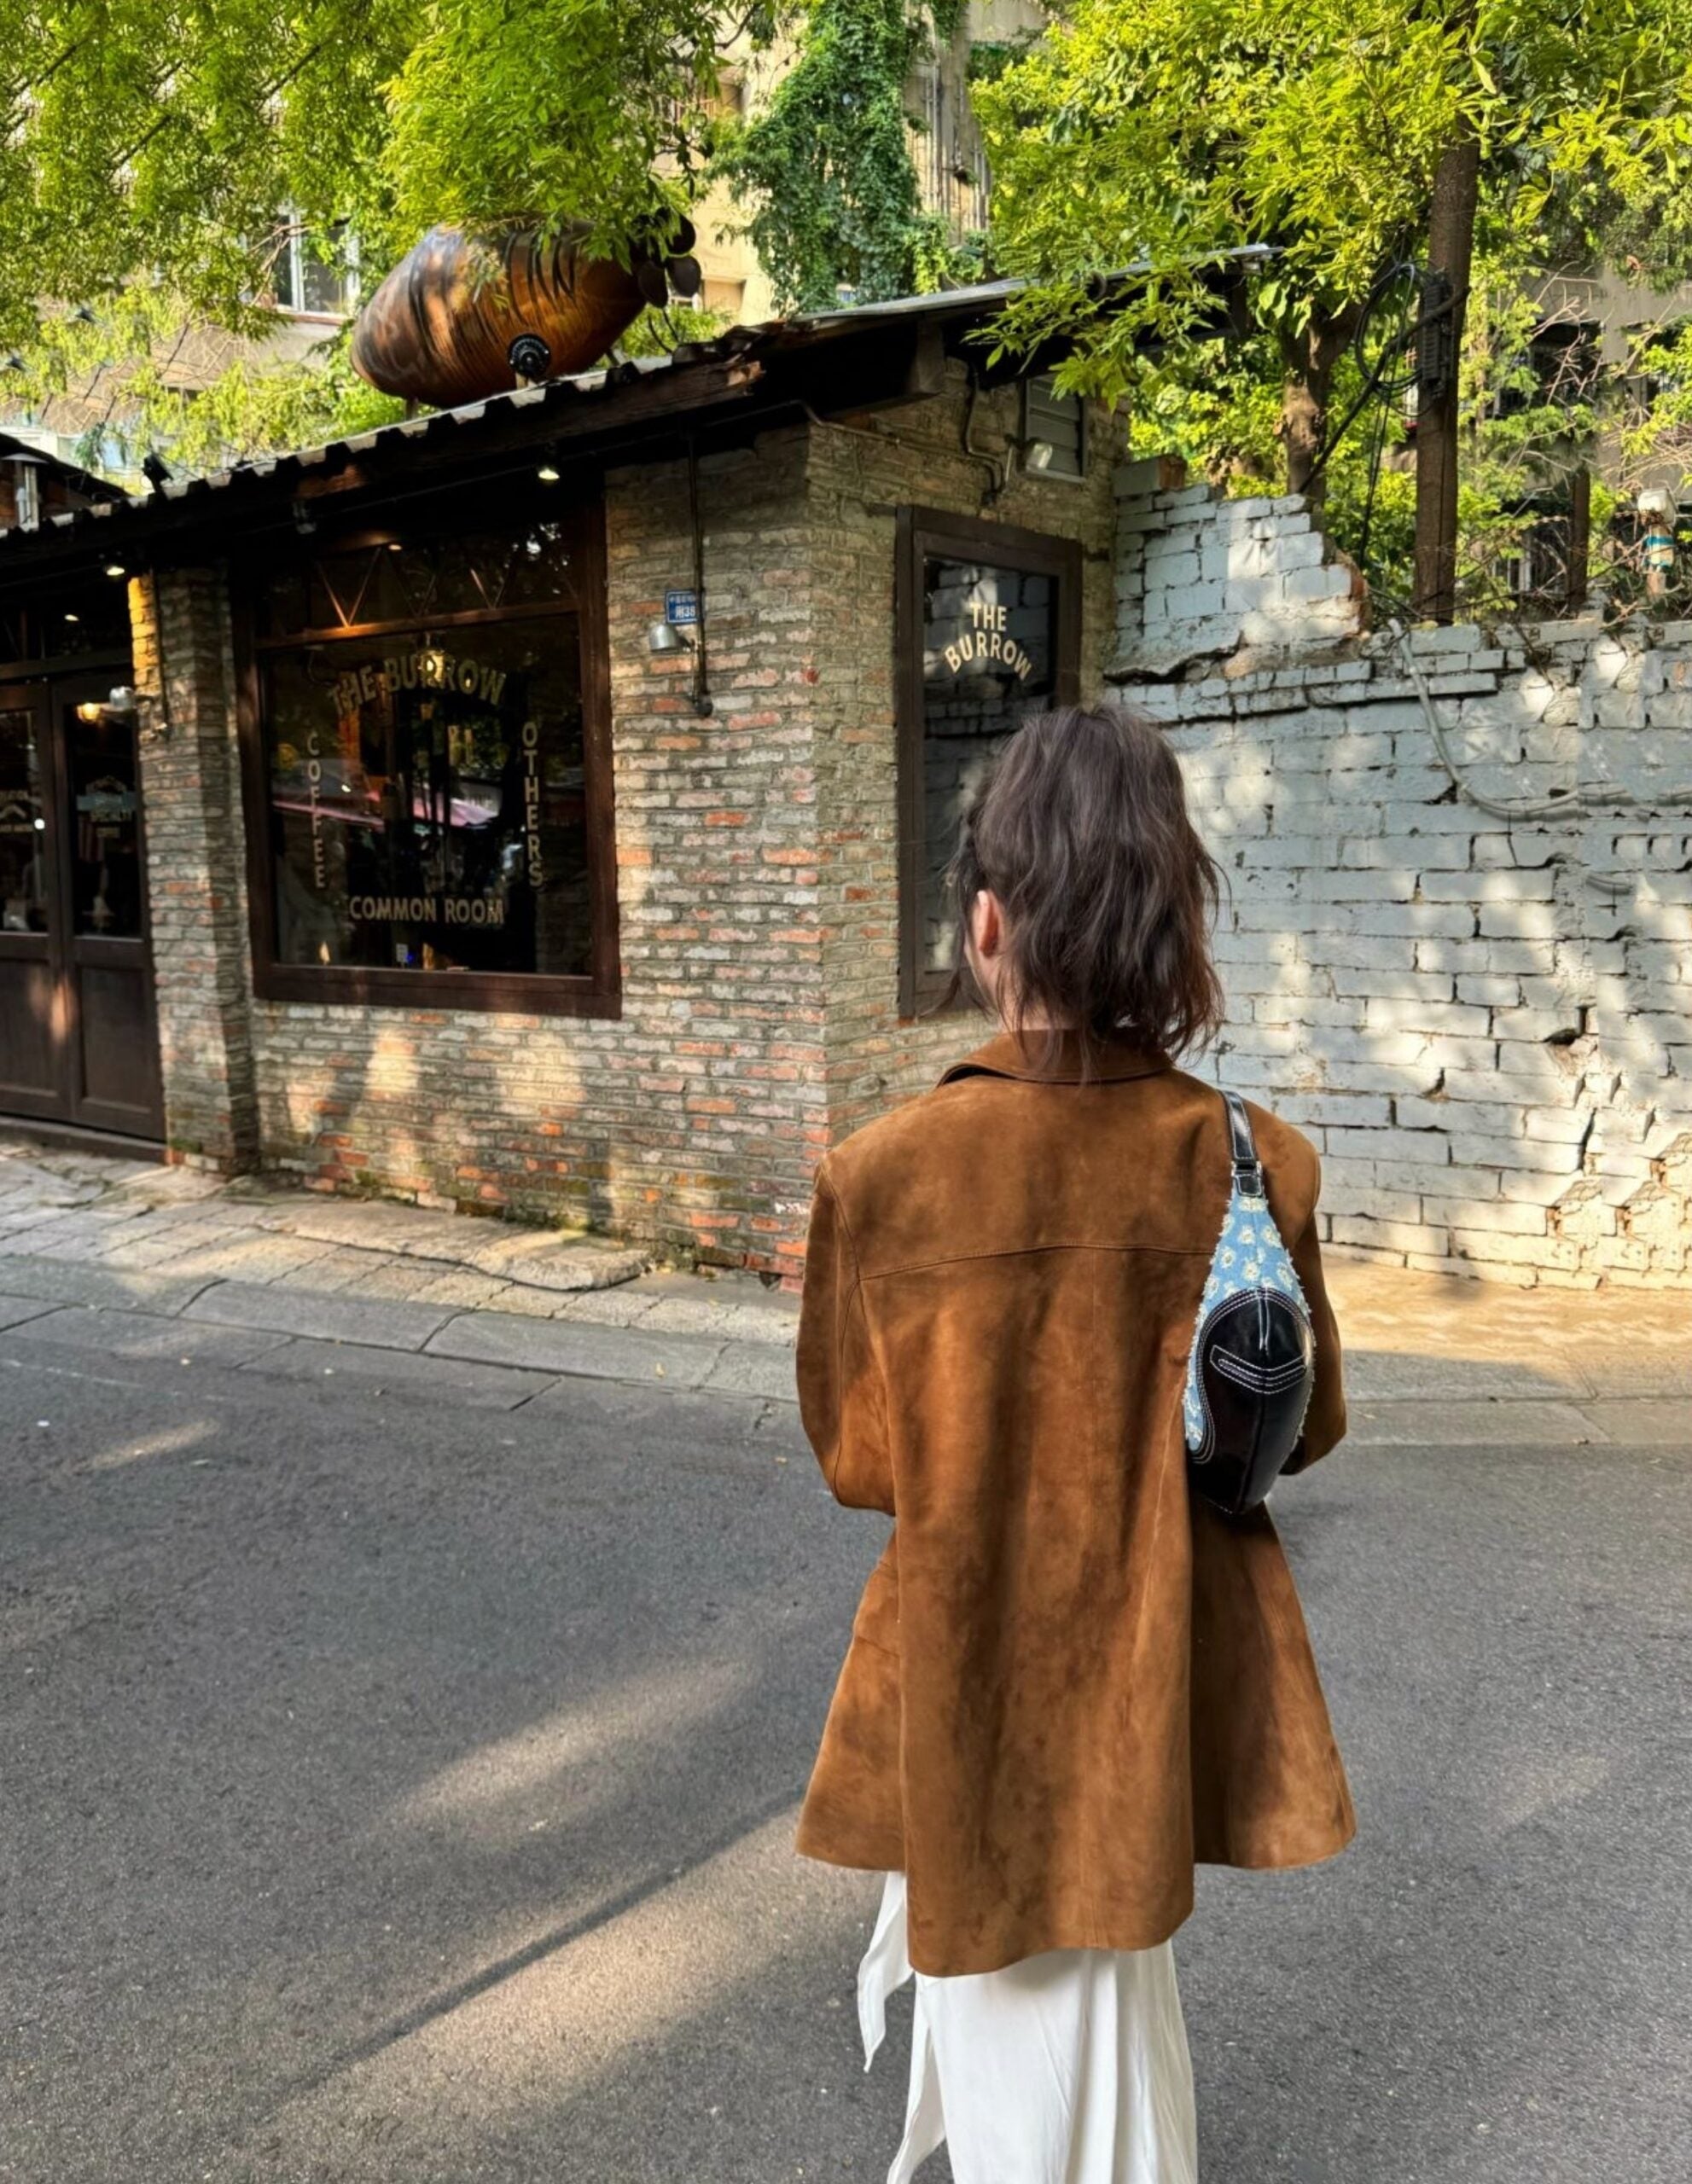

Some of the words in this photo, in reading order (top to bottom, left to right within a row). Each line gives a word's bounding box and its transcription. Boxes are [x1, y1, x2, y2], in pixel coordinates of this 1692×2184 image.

[969, 601, 1007, 631] THE
[945, 631, 1032, 681] BURROW
[327, 665, 377, 715] THE
[384, 654, 507, 706] BURROW
[307, 730, 326, 889] COFFEE
[522, 721, 544, 887] OTHERS
[350, 896, 437, 921] COMMON
[445, 898, 504, 925] ROOM
